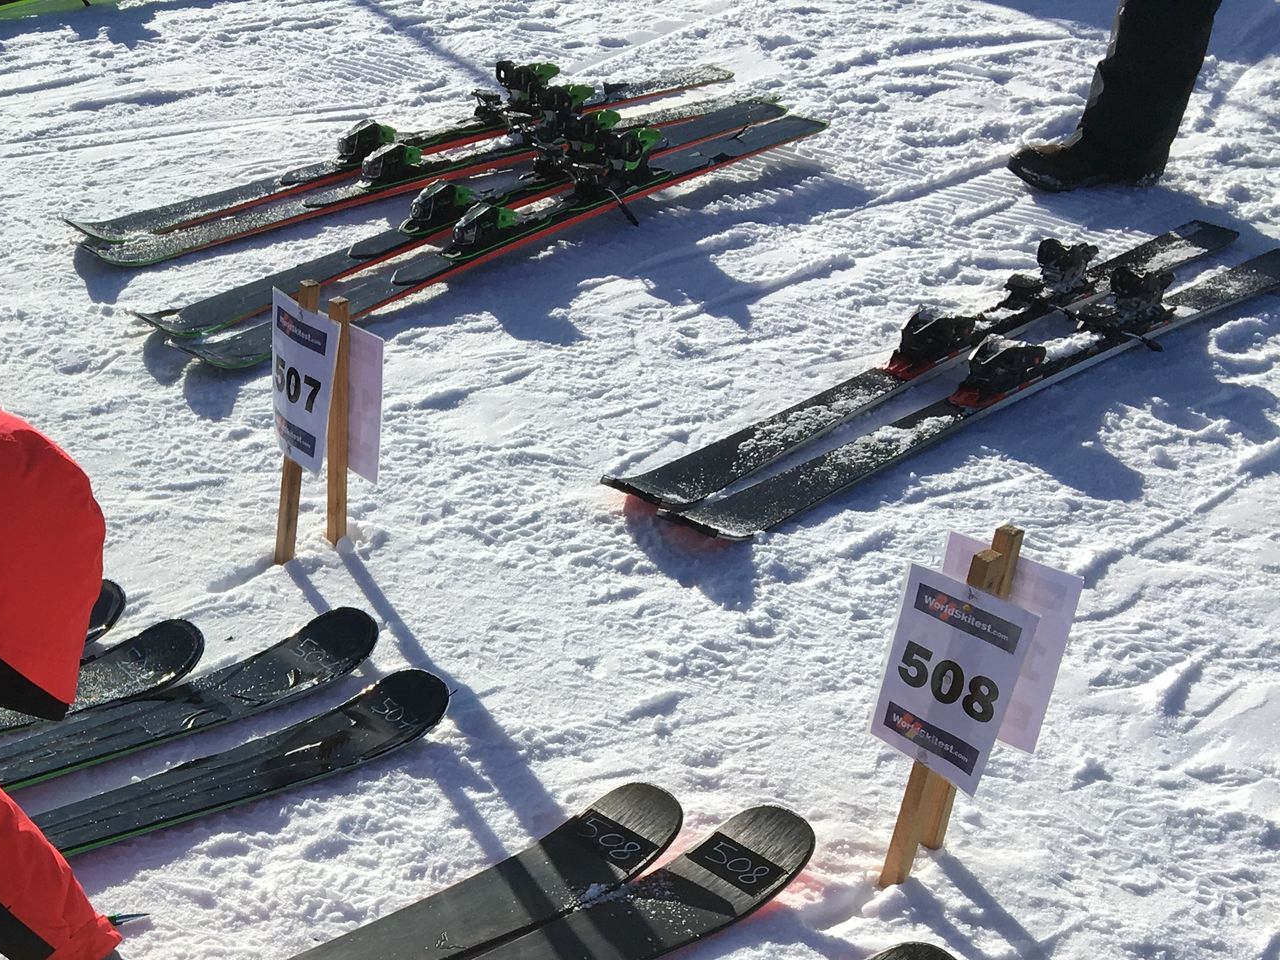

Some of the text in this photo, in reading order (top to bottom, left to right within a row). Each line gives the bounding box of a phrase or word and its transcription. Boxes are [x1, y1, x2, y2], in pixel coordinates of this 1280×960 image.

[274, 354, 322, 414] 507
[924, 594, 1010, 642] WorldSkitest.com
[897, 639, 1000, 723] 508
[577, 817, 641, 860] 508
[704, 841, 770, 884] 508
